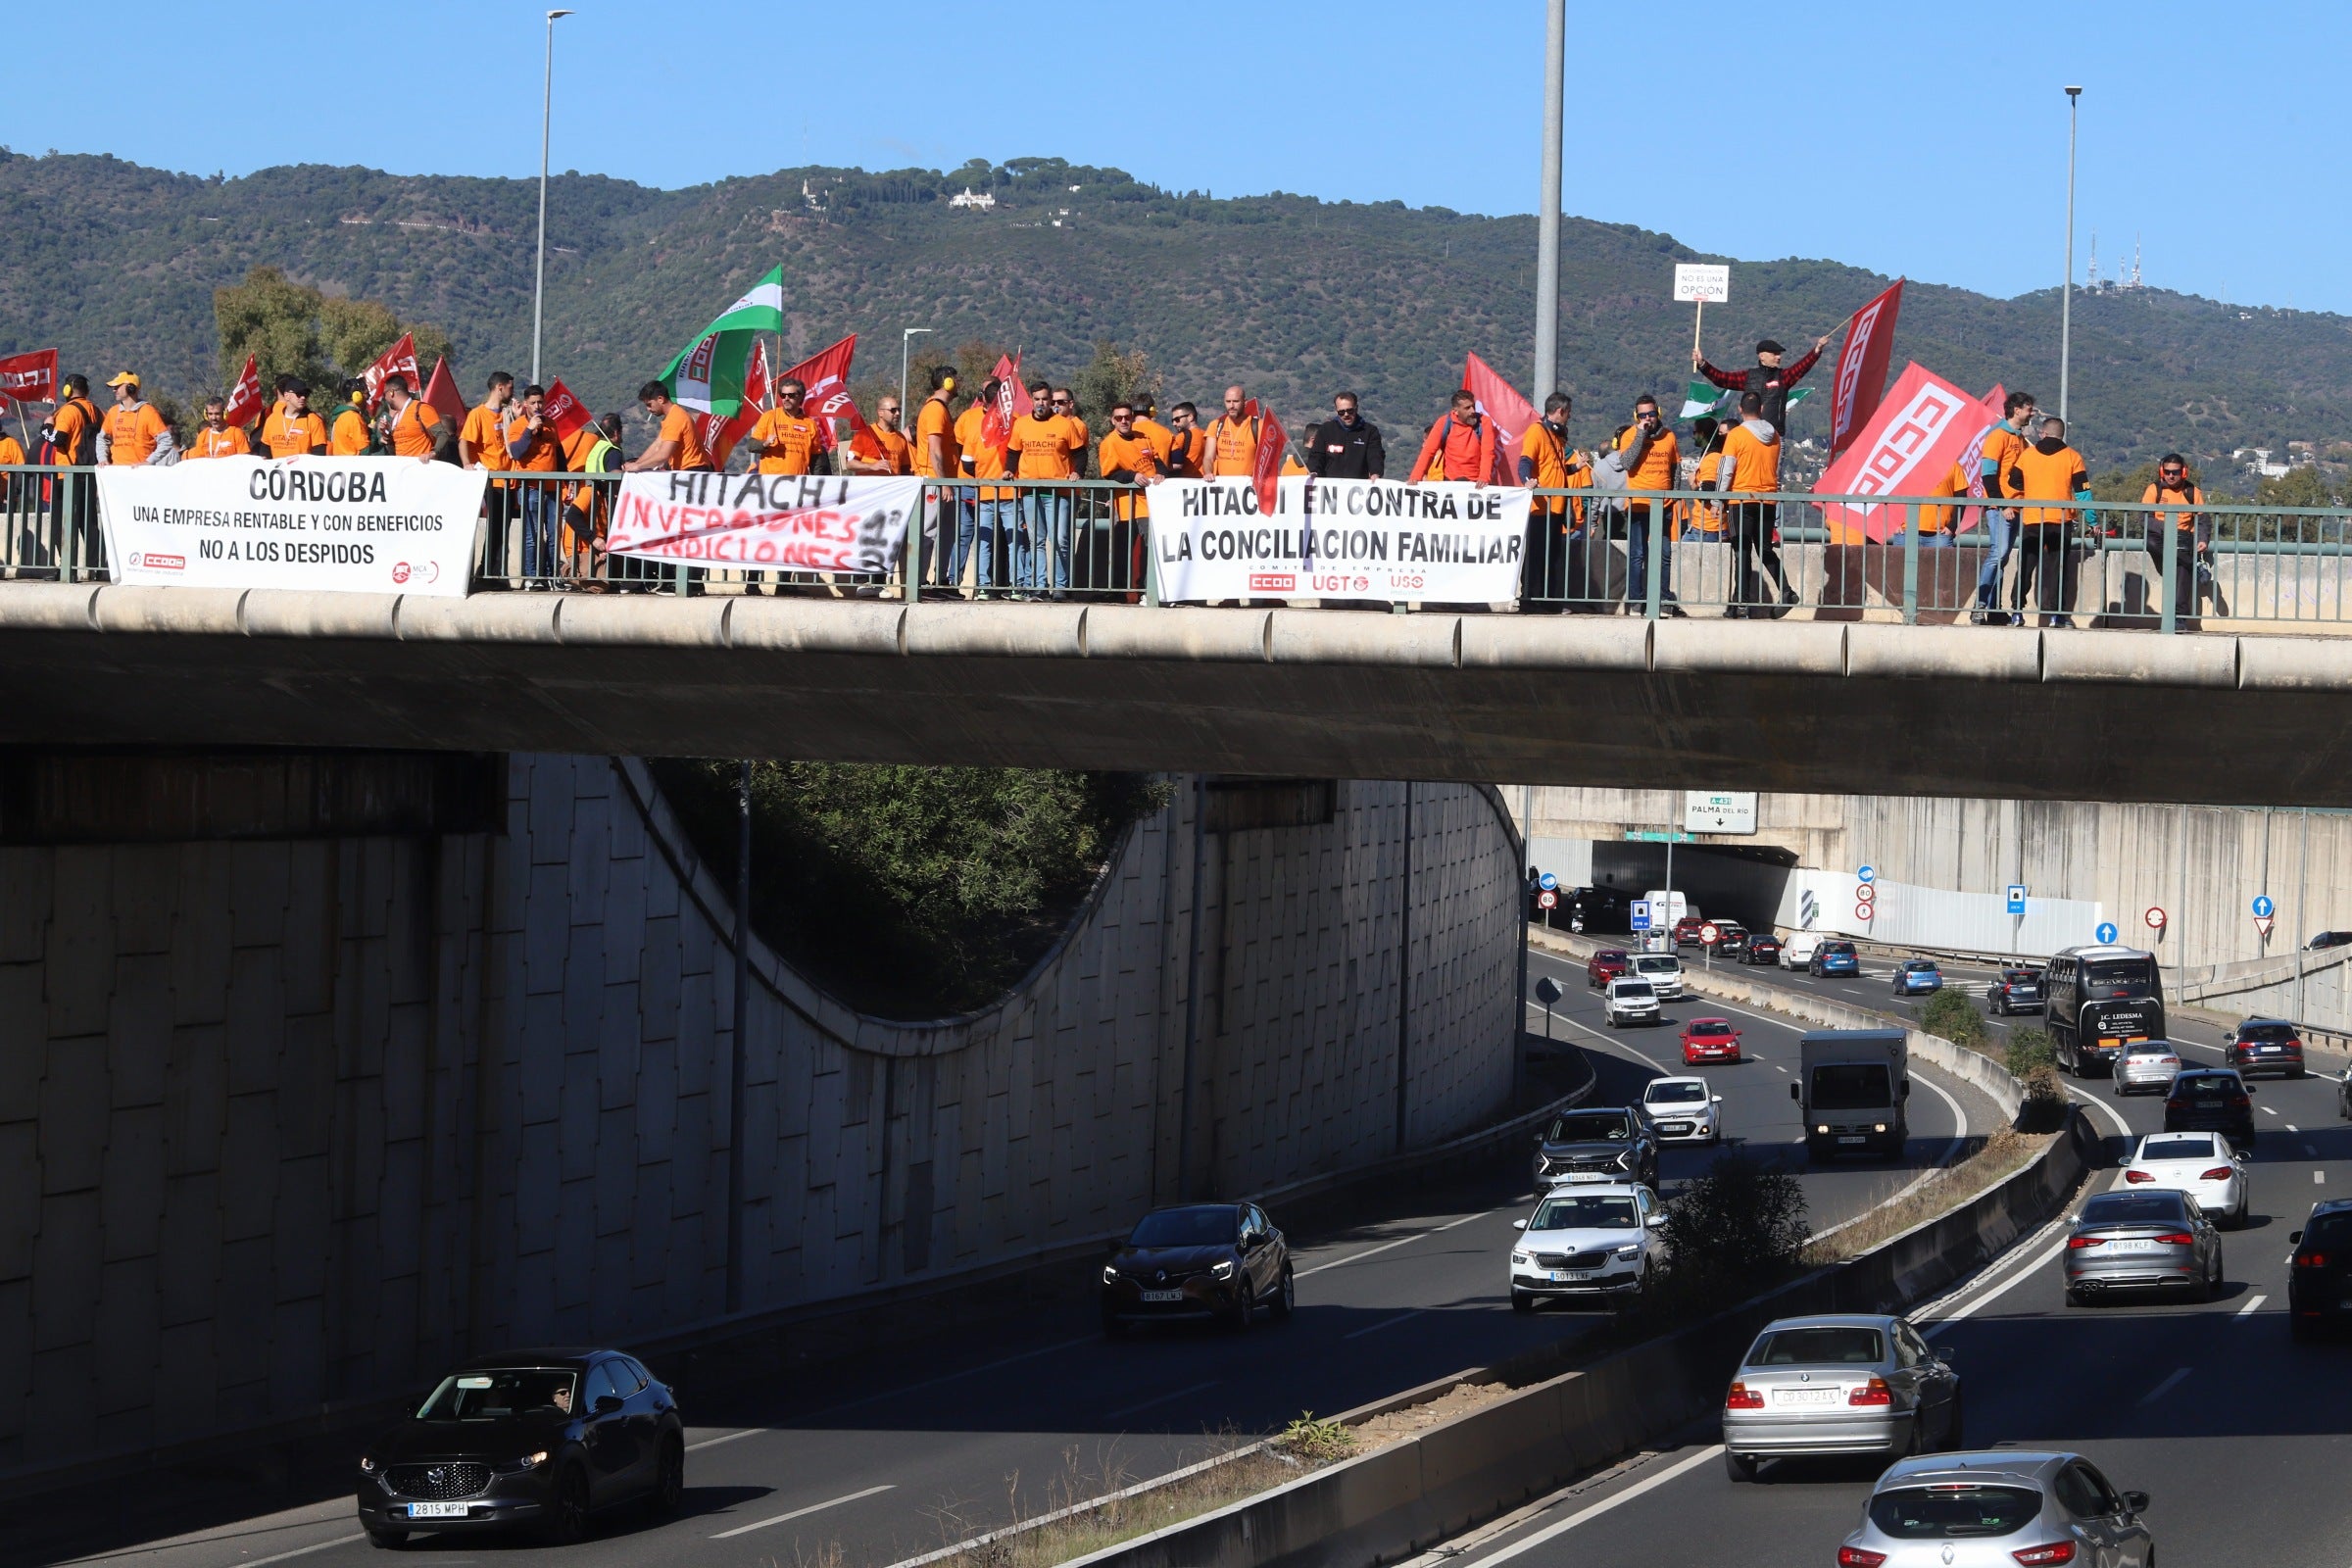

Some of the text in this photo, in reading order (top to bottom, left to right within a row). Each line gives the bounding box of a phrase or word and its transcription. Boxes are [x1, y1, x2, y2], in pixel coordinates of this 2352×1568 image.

[1681, 284, 1724, 295] OPCIÓN
[249, 463, 387, 503] CÓRDOBA
[669, 471, 849, 510] HITACHI
[1182, 484, 1501, 520] HITACI EN CONTRA DE
[132, 505, 443, 531] UNA EMPRESA RENTABLE Y CON BENEFICIOS
[199, 539, 374, 564] NO A LOS DESPIDOS
[1162, 528, 1522, 564] LA CONCILIACION FAMILIAR
[1352, 565, 1427, 574] EMPRESA
[1250, 575, 1294, 590] CCOO
[1312, 575, 1351, 591] UGT
[1391, 575, 1424, 589] USO
[416, 1503, 466, 1515] 2815 MPH
